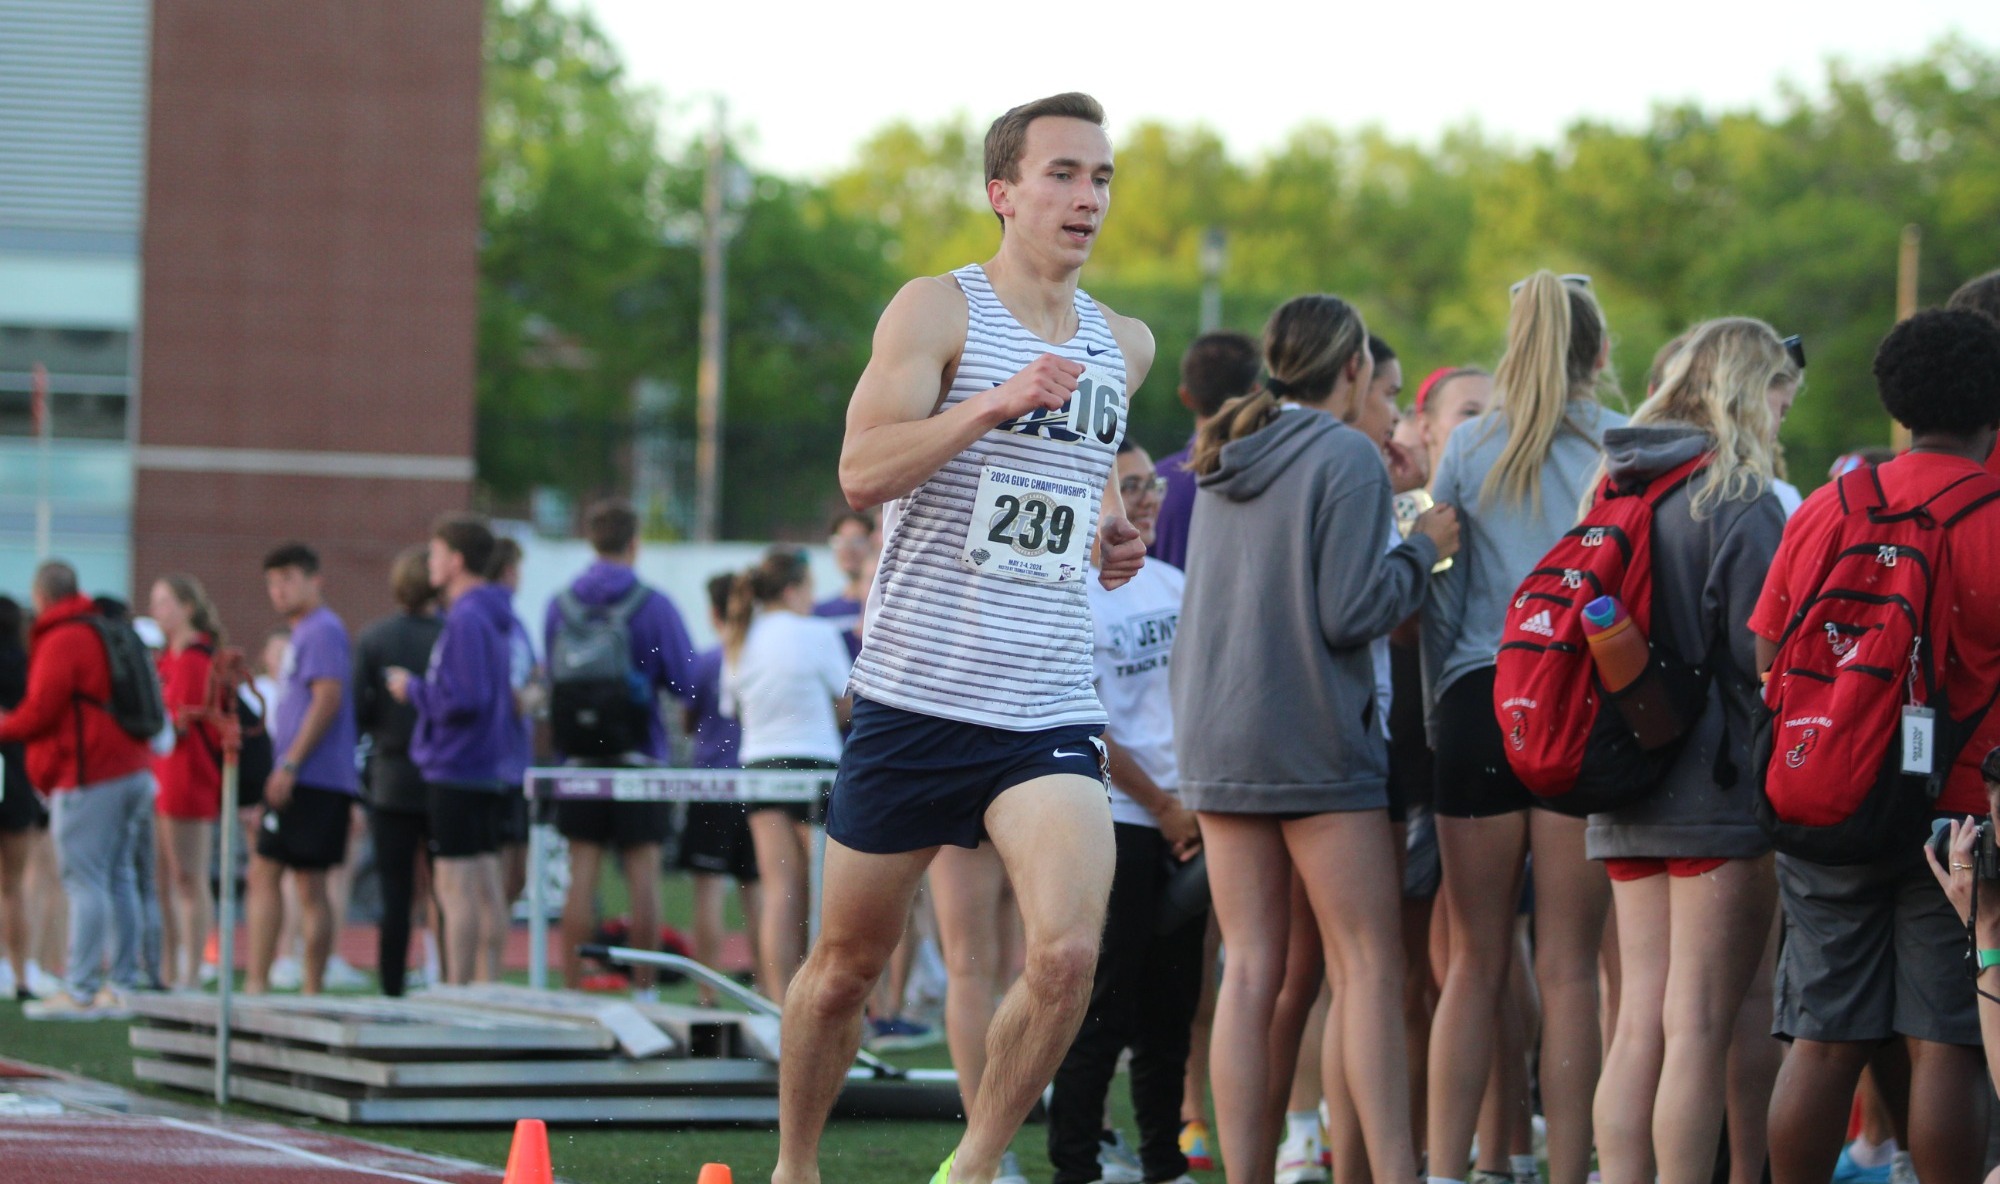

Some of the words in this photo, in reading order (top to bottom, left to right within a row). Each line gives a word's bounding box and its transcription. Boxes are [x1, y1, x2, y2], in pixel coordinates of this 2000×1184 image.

[1077, 378, 1119, 445] 16
[991, 471, 1010, 485] 2024
[1011, 474, 1030, 488] GLVC
[1031, 479, 1087, 499] CHAMPIONSHIPS
[987, 494, 1075, 555] 239
[1008, 558, 1019, 567] MAY
[1029, 562, 1042, 571] 2024
[1784, 716, 1811, 728] TRACK
